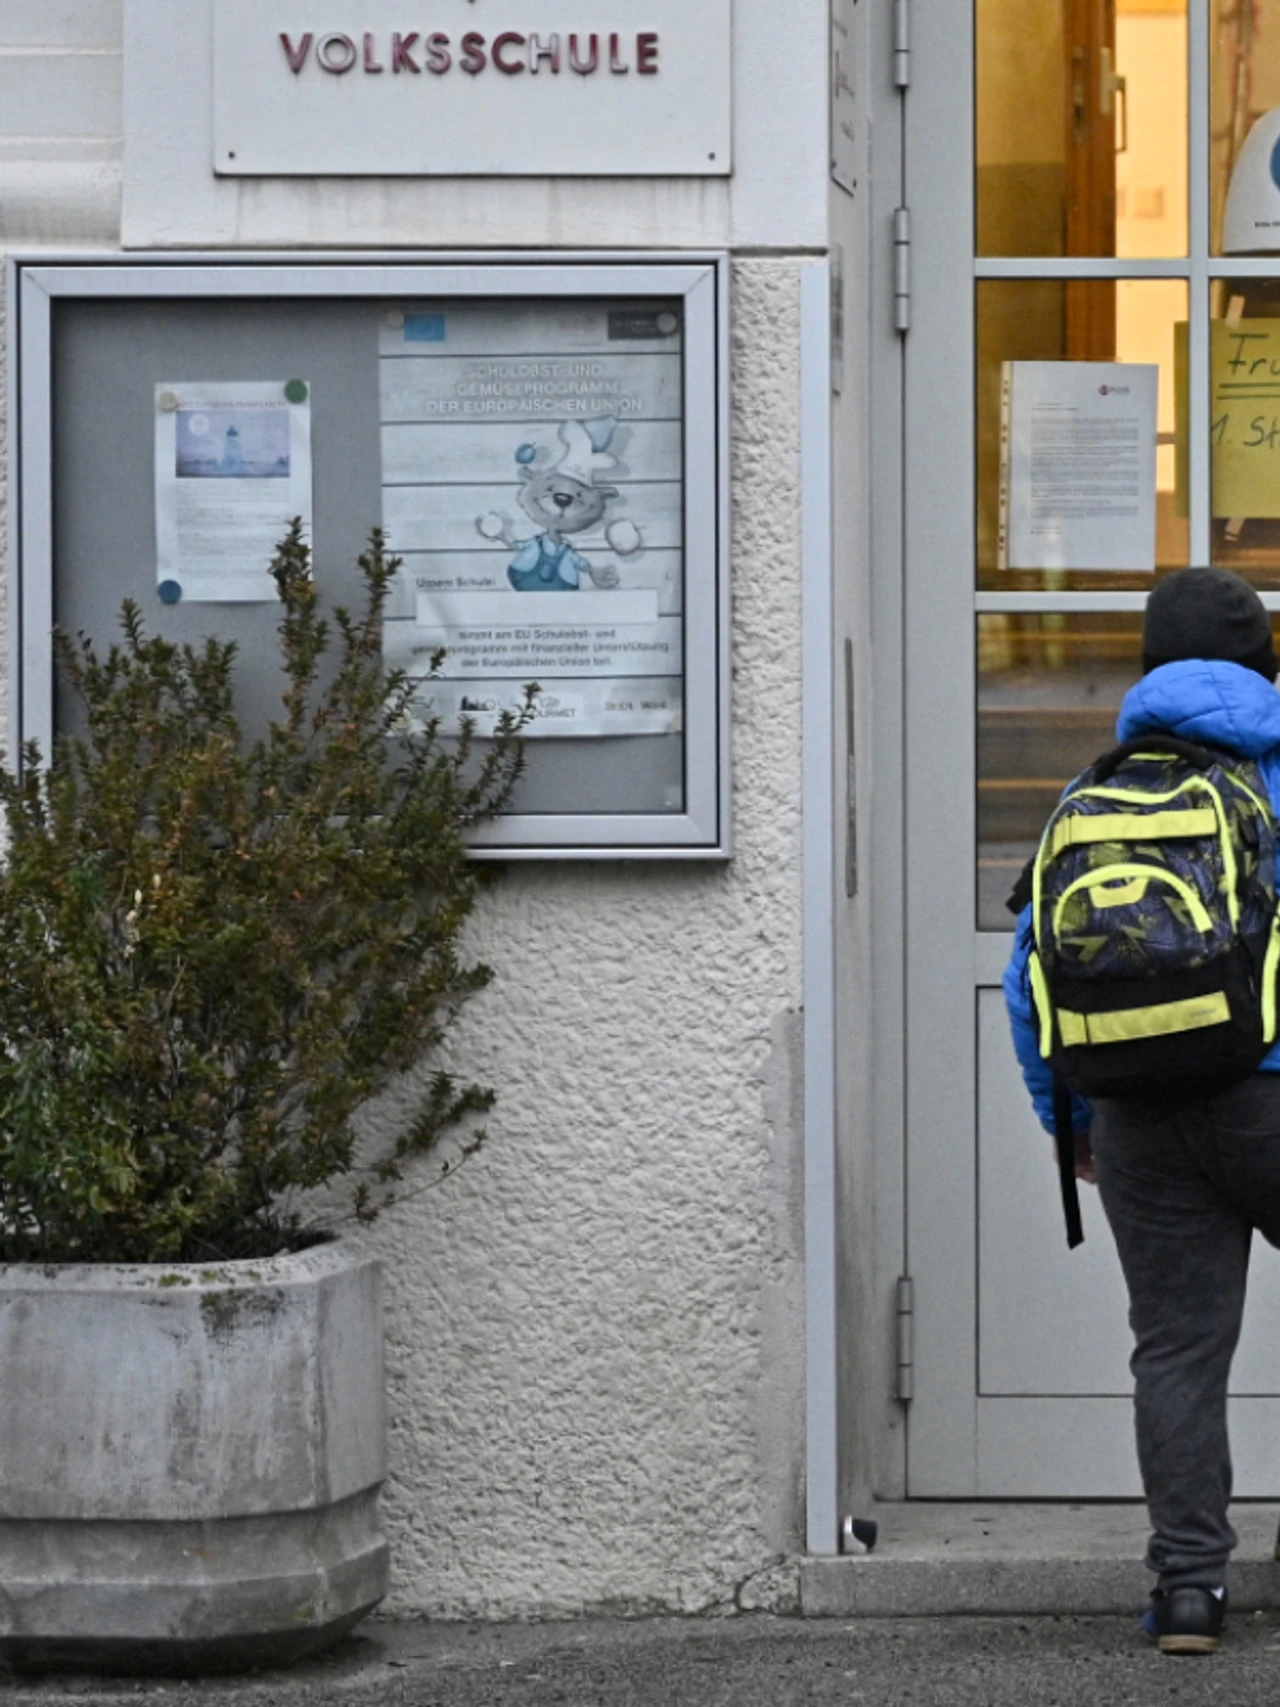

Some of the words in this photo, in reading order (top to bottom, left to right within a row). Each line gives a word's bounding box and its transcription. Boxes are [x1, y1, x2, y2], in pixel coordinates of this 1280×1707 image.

[278, 31, 660, 76] VOLKSSCHULE
[568, 363, 604, 378] UND
[427, 398, 460, 413] DER
[590, 395, 644, 412] UNION
[514, 629, 530, 640] EU
